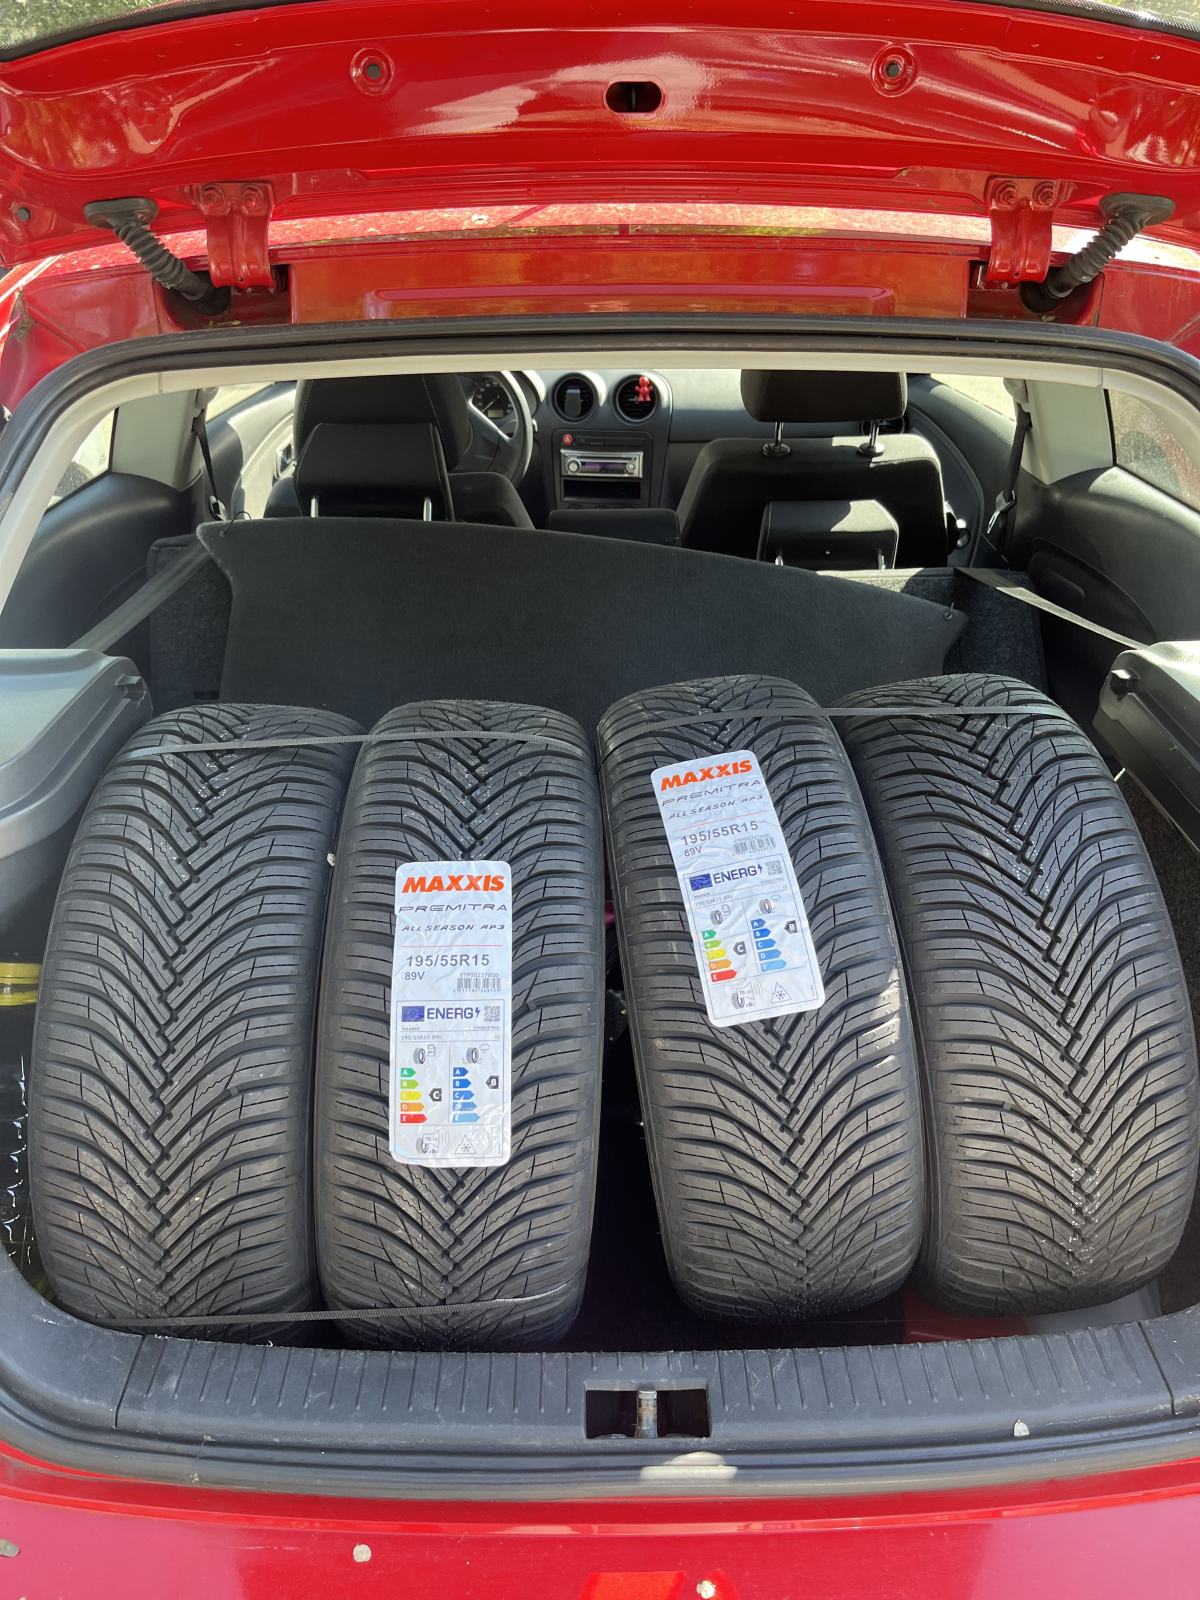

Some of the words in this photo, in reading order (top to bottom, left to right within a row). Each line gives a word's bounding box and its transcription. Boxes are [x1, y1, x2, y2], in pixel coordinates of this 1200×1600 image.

[661, 760, 752, 791] MAXXIS
[662, 780, 760, 806] PREMITRA
[668, 812, 687, 820] ALL
[690, 800, 735, 815] SEASON
[740, 795, 763, 804] AP3
[682, 820, 758, 846] 195/55R15
[684, 846, 702, 857] 89V
[713, 865, 757, 884] ENERG
[402, 875, 504, 894] MAXXIS
[399, 904, 507, 913] PREMITRA
[406, 954, 490, 967] 195/55R15
[404, 971, 425, 981] 89V
[427, 1007, 474, 1020] ENERG
